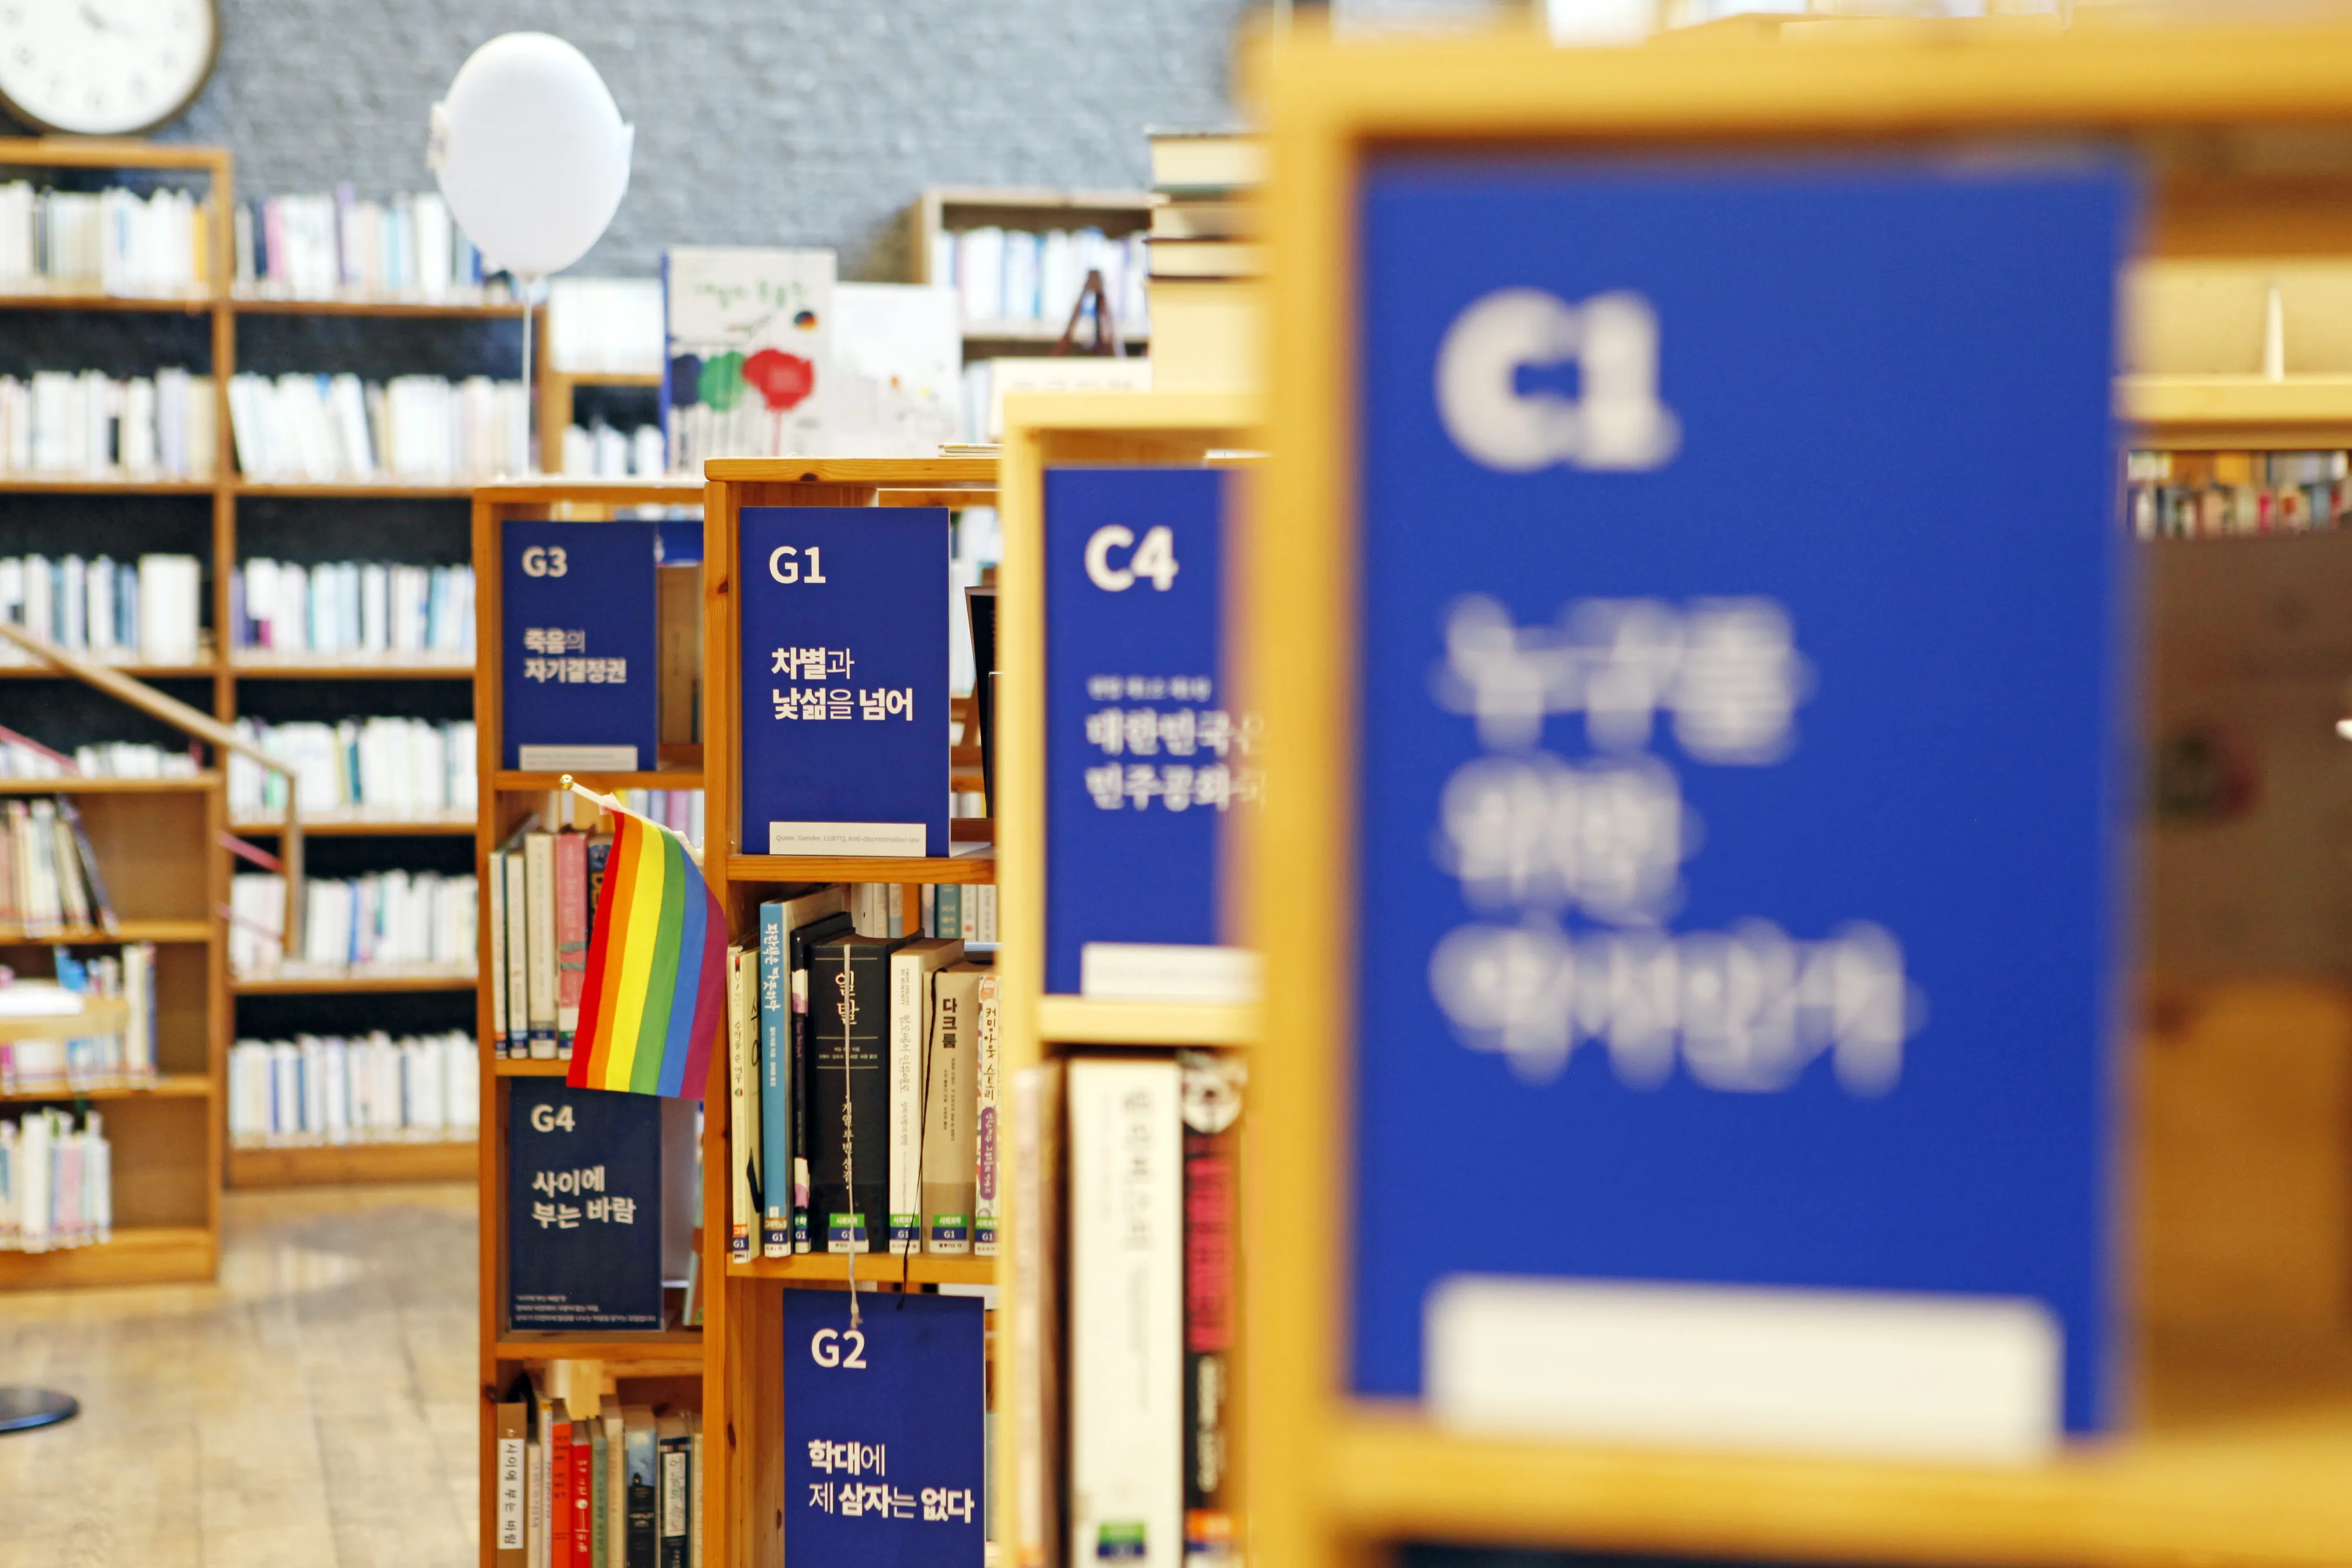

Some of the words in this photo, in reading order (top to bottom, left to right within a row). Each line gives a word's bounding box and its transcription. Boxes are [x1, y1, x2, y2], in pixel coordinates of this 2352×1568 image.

[1435, 286, 1682, 471] C1
[522, 546, 568, 577] G3
[769, 546, 826, 584] G1
[1085, 524, 1178, 591] C4
[524, 627, 585, 654] 죽음의
[524, 657, 627, 683] 자기결정권
[771, 647, 855, 680] 차별과
[773, 688, 854, 720] 낯섦을
[860, 688, 913, 721] 넘어
[762, 922, 781, 965] 파란색은
[763, 967, 781, 1012] 따뜻하다
[943, 998, 957, 1048] 다크룸
[984, 1008, 997, 1059] 커밍아웃
[983, 1064, 996, 1101] 스토리
[530, 1104, 576, 1132] G4
[532, 1165, 605, 1198] 사이에
[532, 1201, 581, 1229] 부는
[586, 1196, 636, 1224] 바람
[733, 1239, 744, 1248] G1
[772, 1233, 784, 1242] G1
[796, 1231, 806, 1239] G1
[898, 1230, 909, 1239] G1
[944, 1230, 955, 1239] G1
[982, 1233, 994, 1241] G1
[811, 1328, 867, 1369] G2
[504, 1443, 518, 1482] 사이에
[808, 1439, 885, 1477] 학대에
[504, 1489, 518, 1513] 부는
[921, 1487, 974, 1523] 없다
[503, 1520, 517, 1545] 바람
